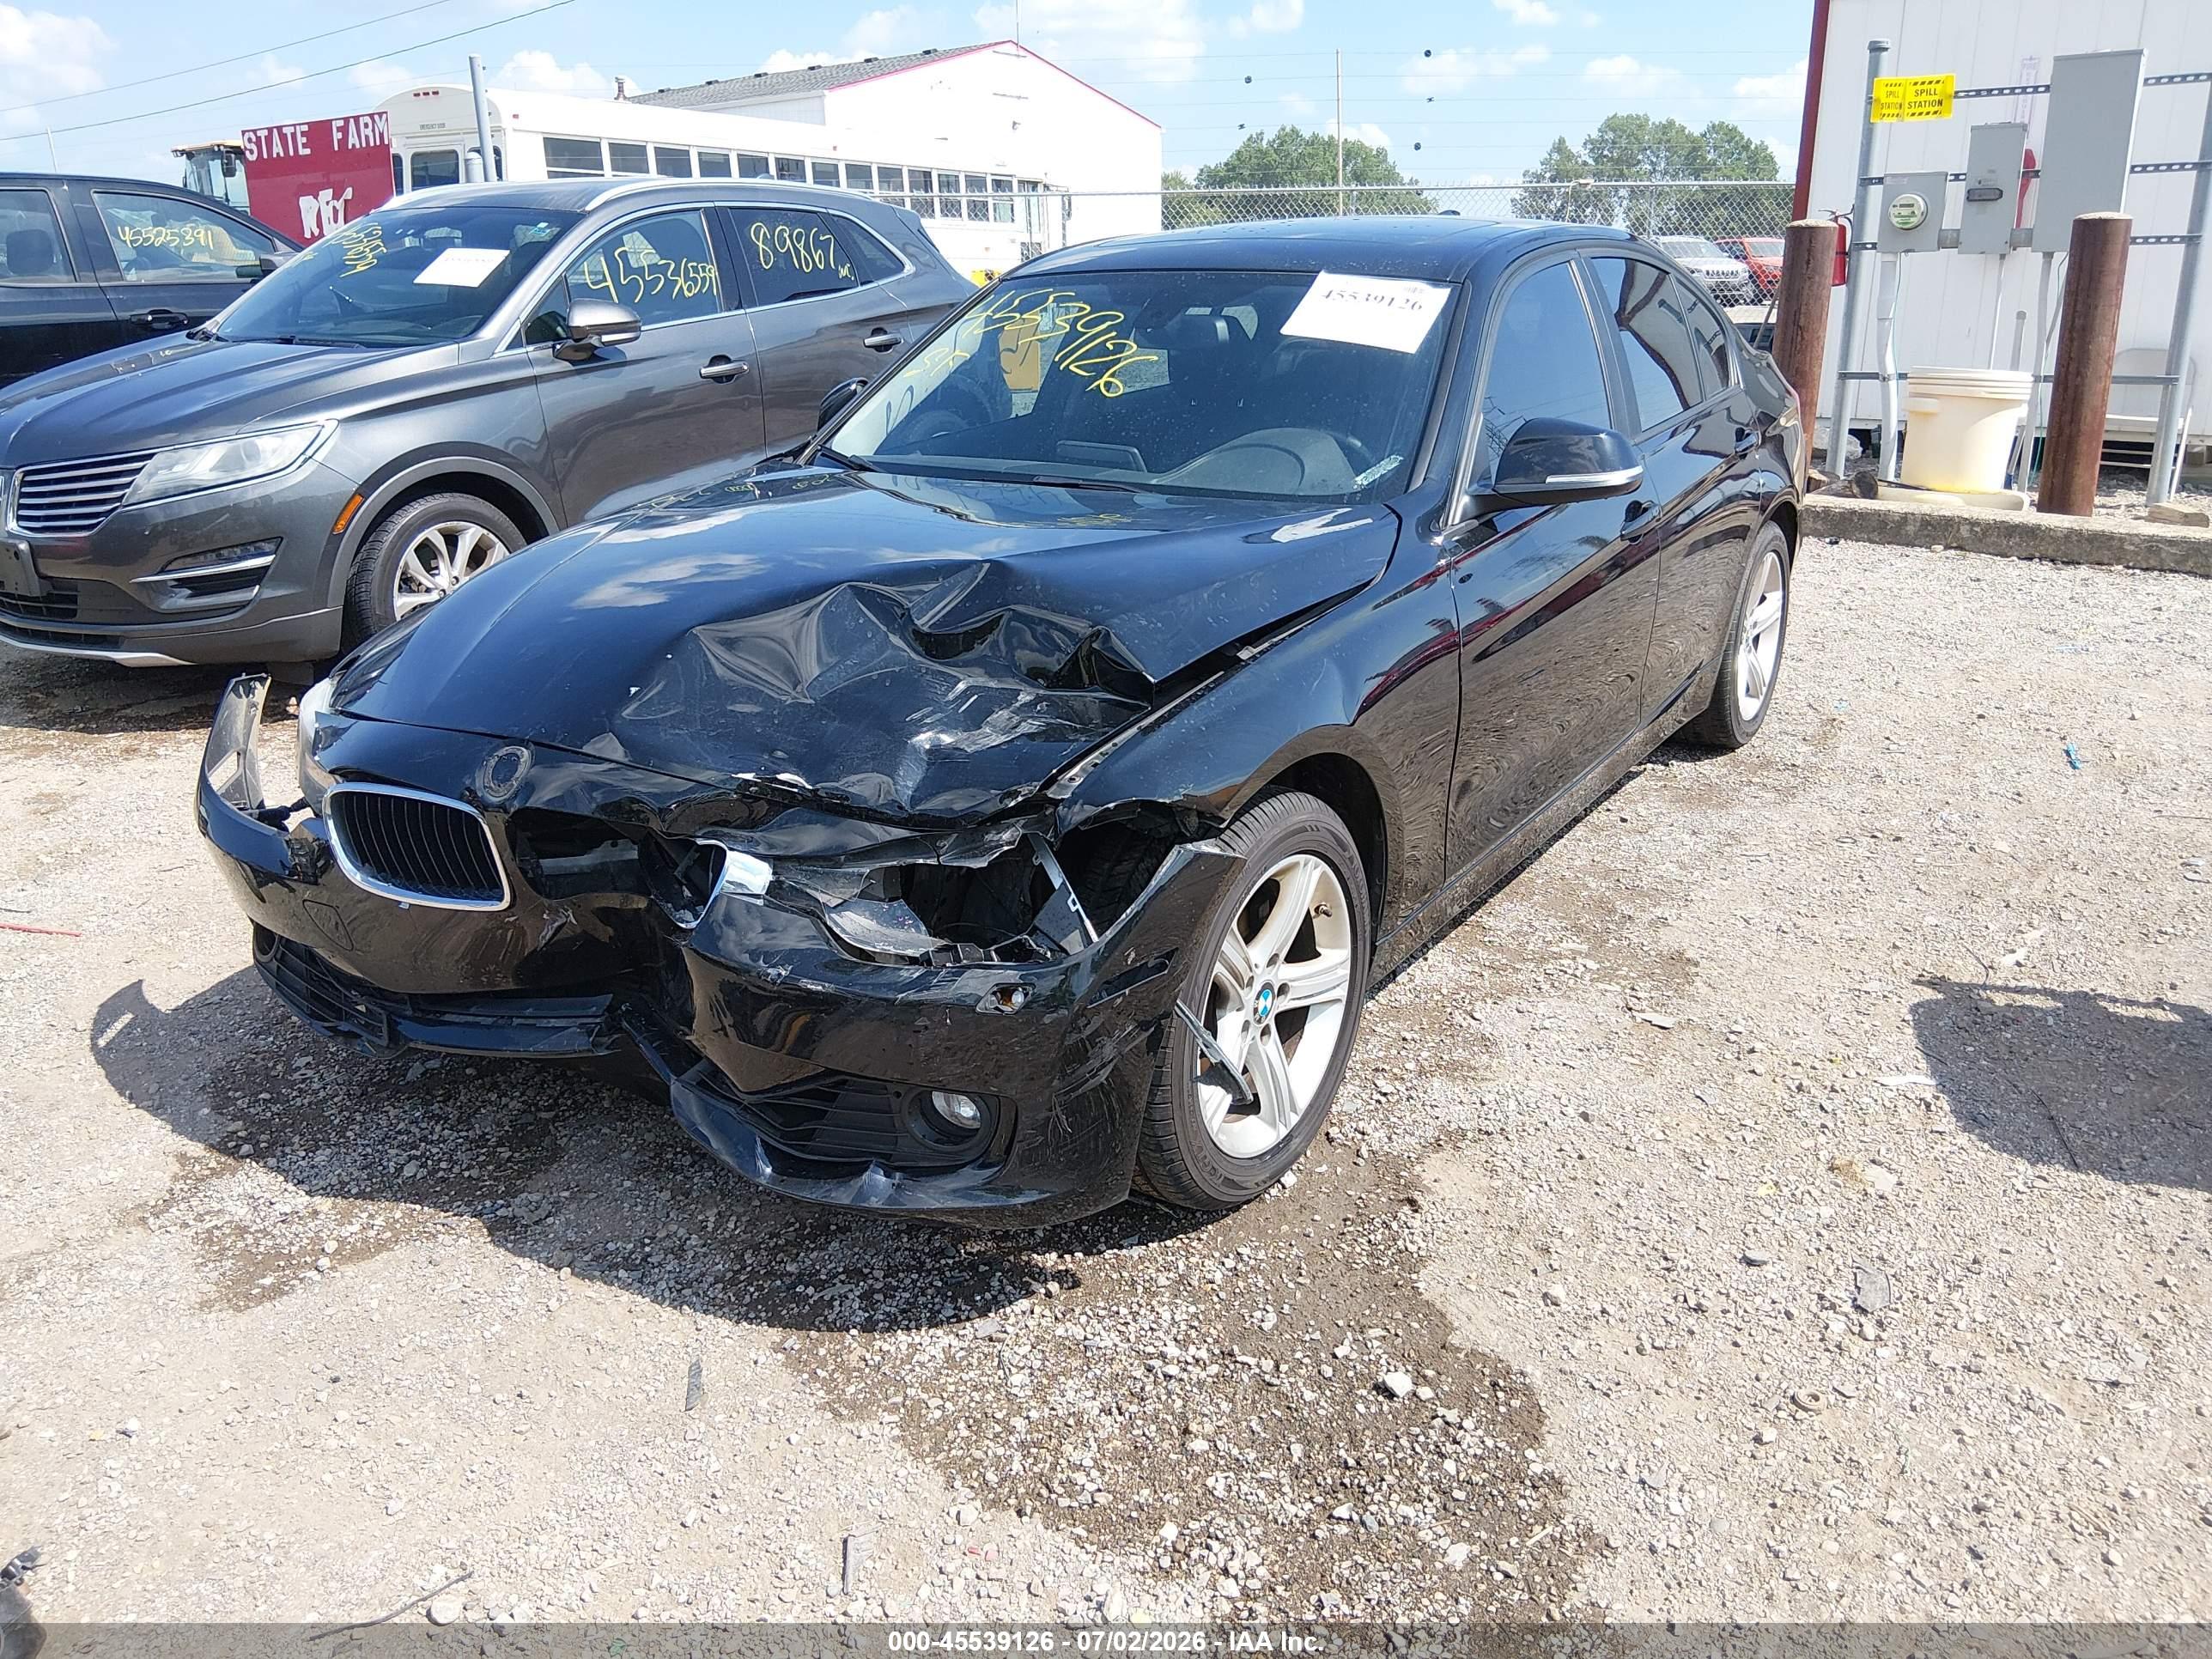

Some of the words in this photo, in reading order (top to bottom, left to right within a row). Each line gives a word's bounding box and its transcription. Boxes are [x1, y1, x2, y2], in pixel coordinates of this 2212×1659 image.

[1886, 90, 1899, 99] SPILL
[1907, 98, 1943, 110] STATION
[1914, 88, 1938, 98] SPILL
[1881, 101, 1903, 111] STATION
[243, 125, 311, 161] STATE
[331, 112, 389, 151] FARM
[117, 223, 214, 250] 45525391
[750, 222, 836, 272] 89867
[583, 246, 718, 303] 45536559
[1321, 289, 1423, 311] 45539126
[961, 289, 1158, 398] 45539126
